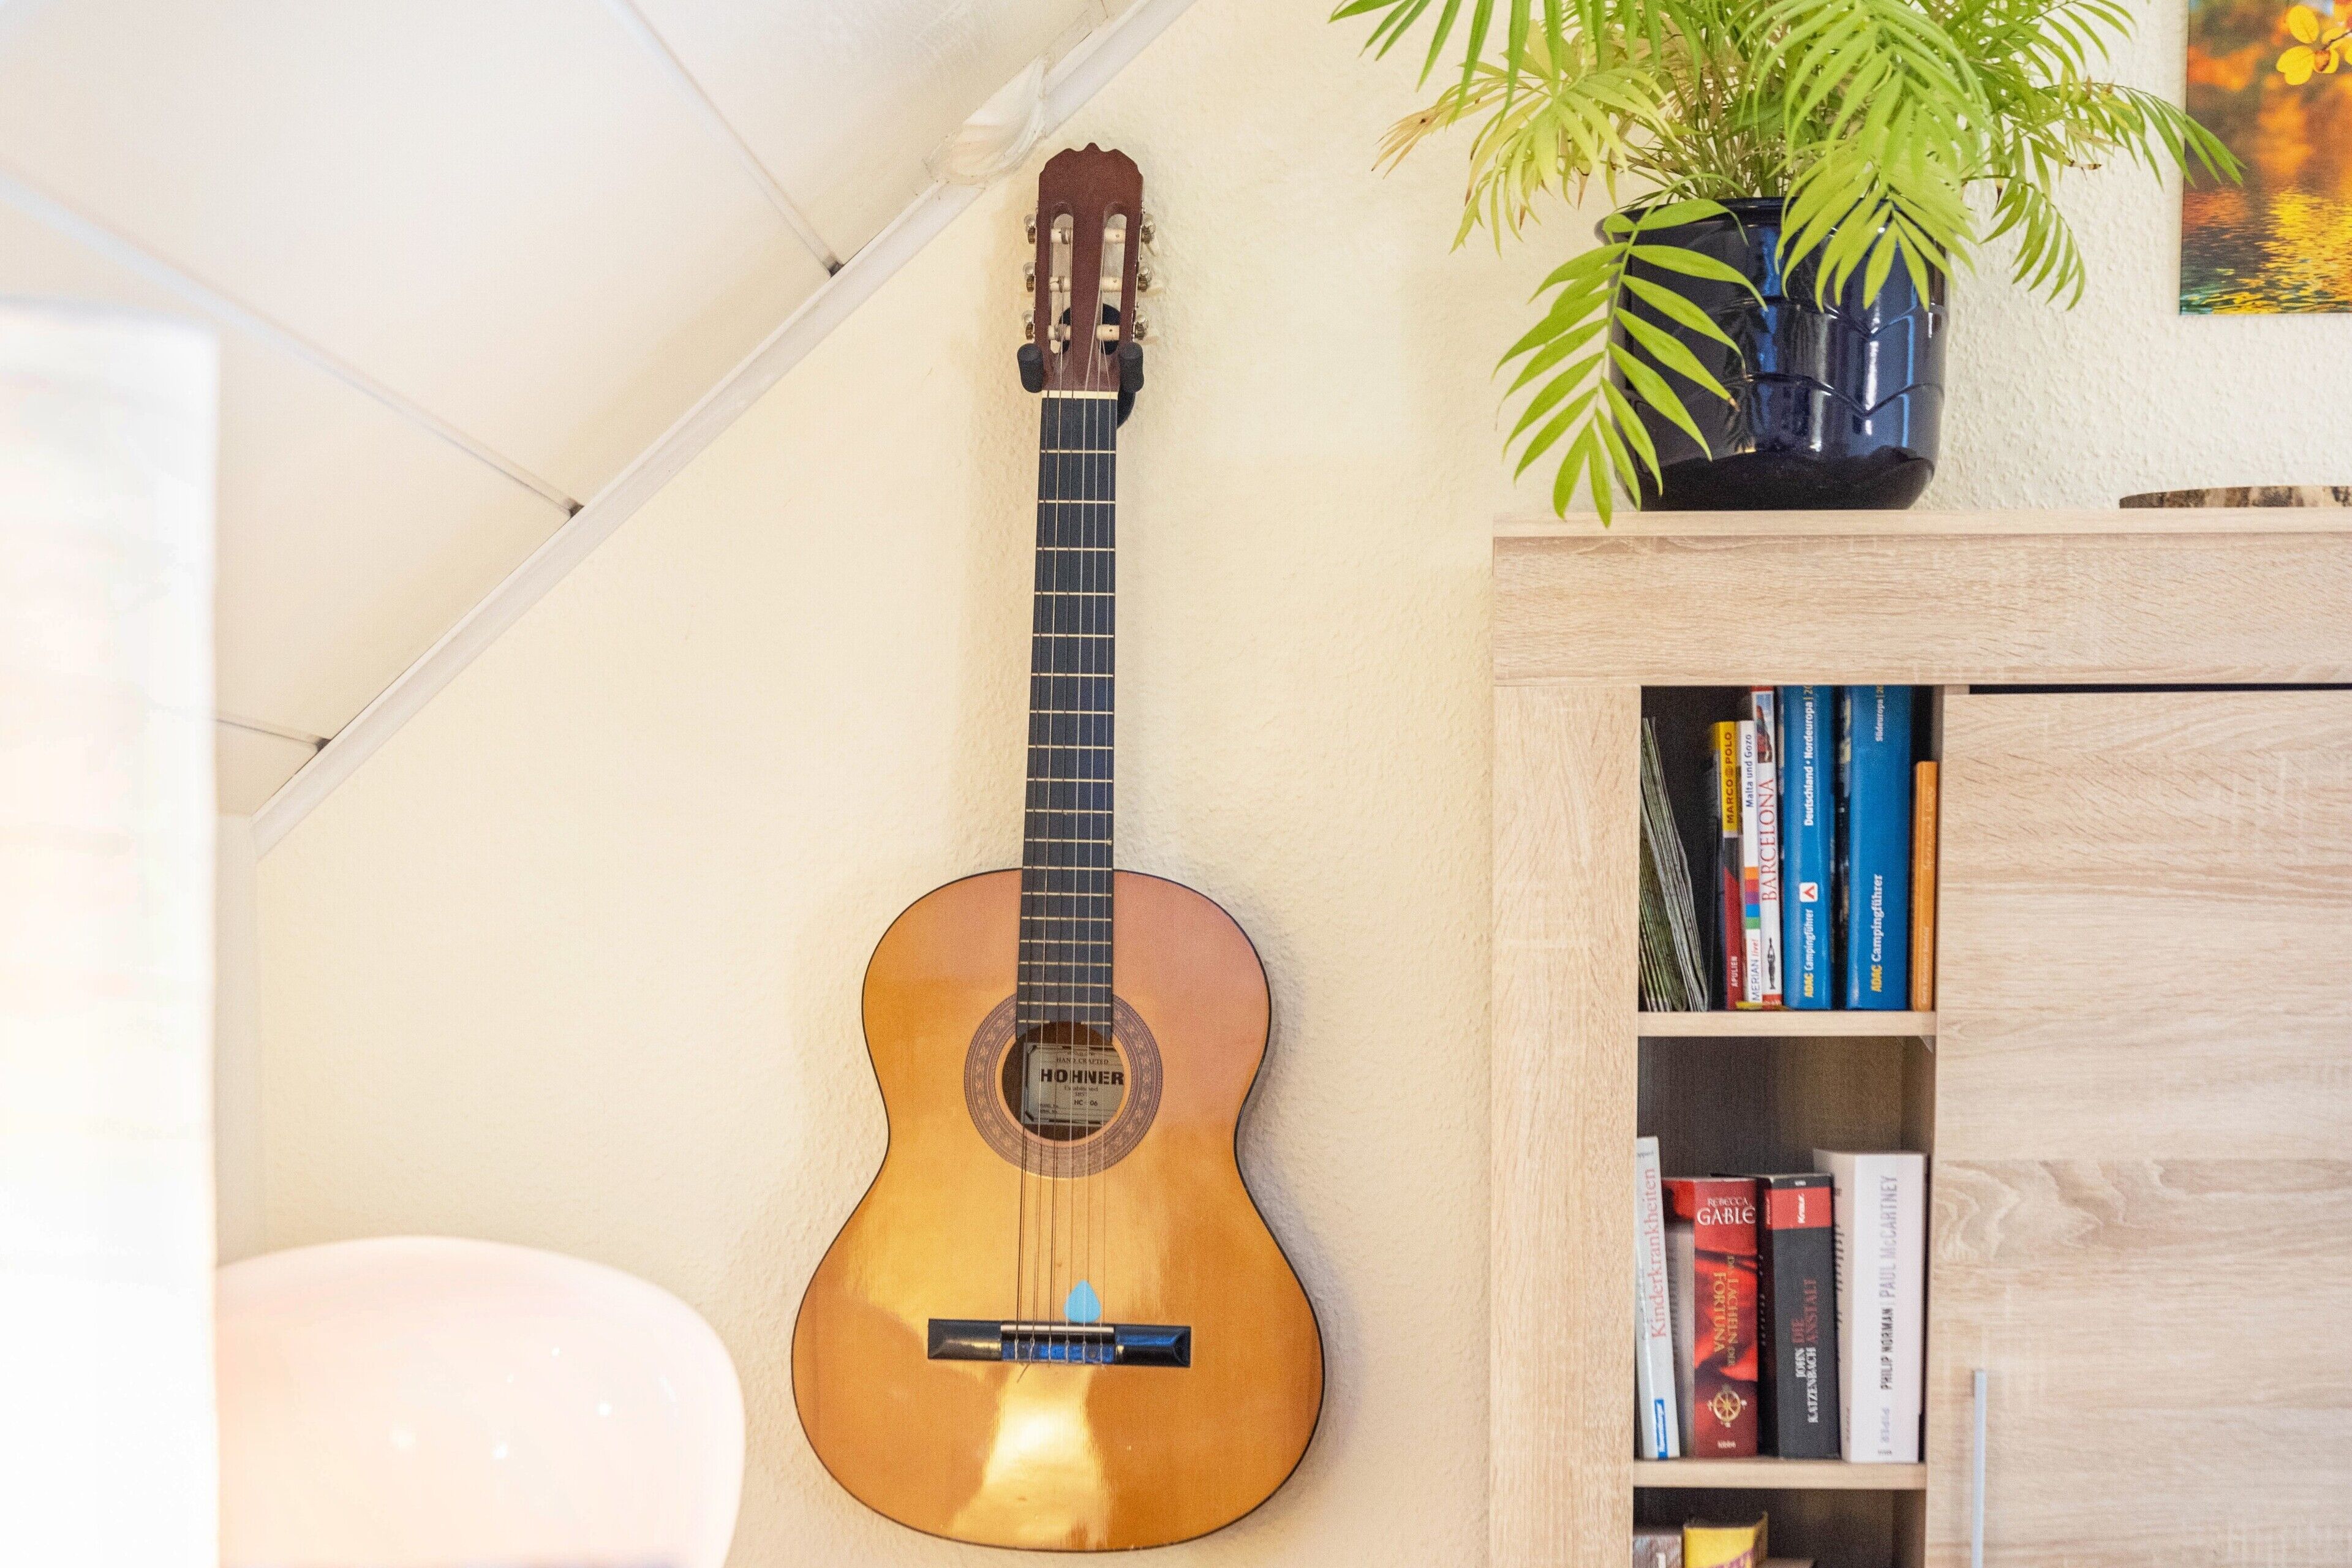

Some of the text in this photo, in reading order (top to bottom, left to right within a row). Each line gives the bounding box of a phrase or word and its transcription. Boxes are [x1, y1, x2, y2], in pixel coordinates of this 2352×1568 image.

[1804, 701, 1815, 759] Nordeuropa
[1724, 732, 1735, 824] MARCO POLO
[1744, 734, 1754, 808] Malta und Gozo
[1804, 766, 1814, 826] Deutschland
[1759, 778, 1777, 901] BARCELONA
[1803, 908, 1815, 998] ADAC Campingführer
[1870, 874, 1884, 992] ADAC Campingführer
[1749, 938, 1760, 1001] MERIAN live!
[1041, 1069, 1124, 1085] HOHNER
[1708, 1197, 1749, 1207] REBECCA
[1880, 1176, 1898, 1259] McCARTNEY
[1643, 1168, 1667, 1338] Kinderkrankheiten
[1879, 1264, 1896, 1298] PAUL
[1713, 1272, 1726, 1352] FORTUNA
[1803, 1276, 1819, 1345] ANSTALT
[1880, 1308, 1894, 1353] NORMAN
[1795, 1348, 1806, 1378] JOHN
[1805, 1347, 1819, 1423] KATZENBACH
[1880, 1355, 1893, 1390] PHILIP
